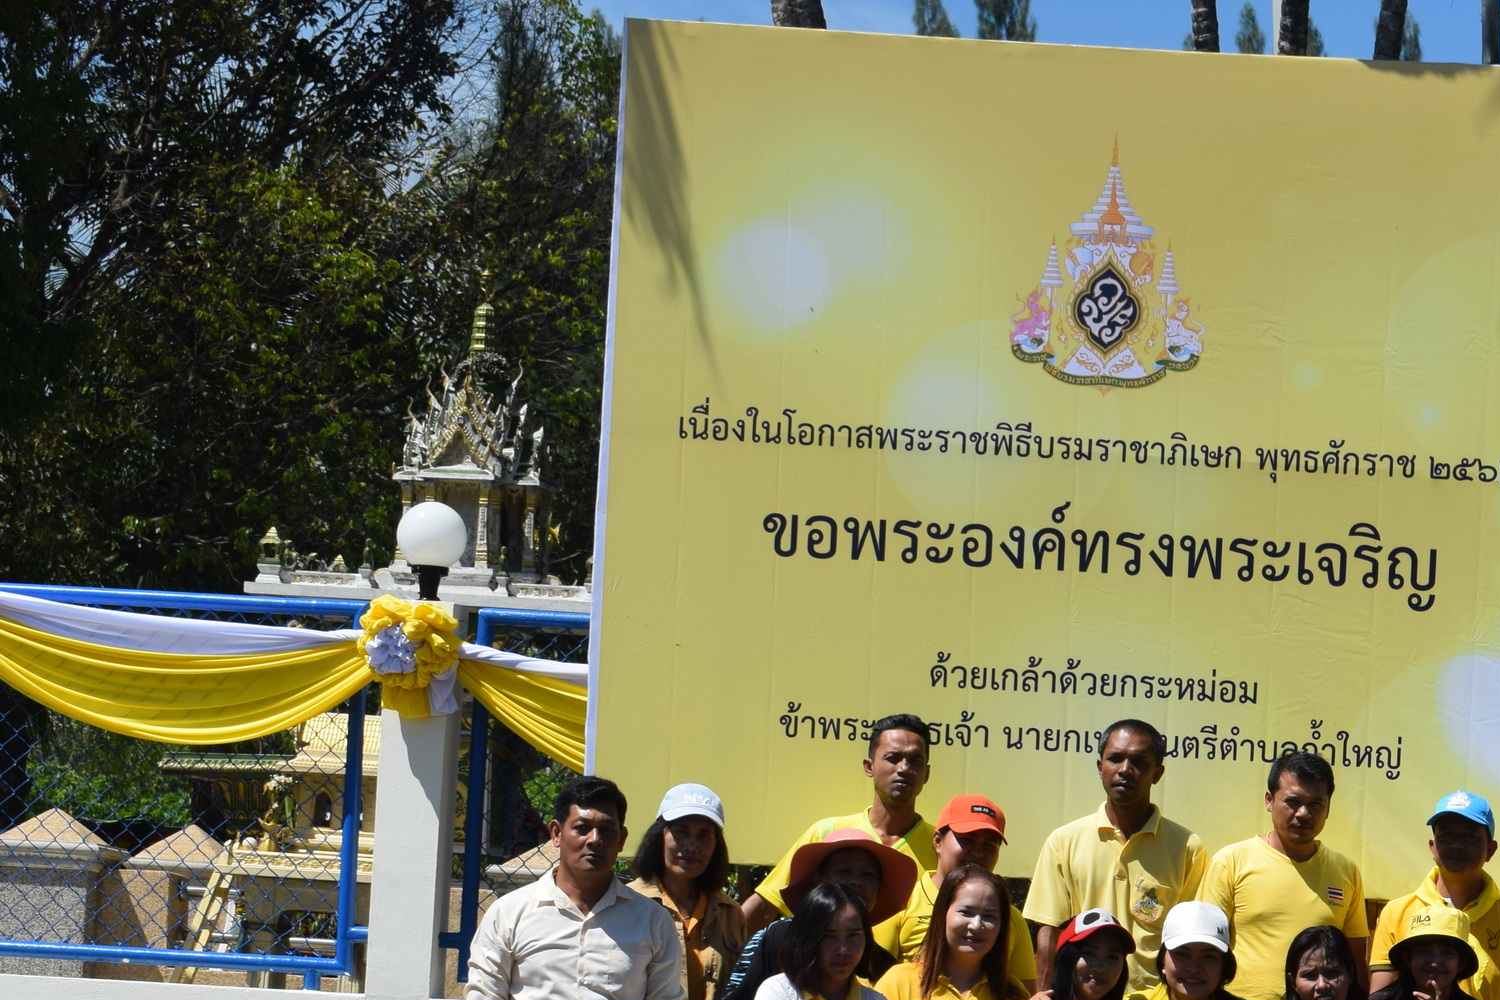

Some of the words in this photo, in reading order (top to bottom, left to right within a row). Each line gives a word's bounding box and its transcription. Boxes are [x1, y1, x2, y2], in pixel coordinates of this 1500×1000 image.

[678, 397, 1242, 469] เนื่องในโอกาสพระราชพิธีบรมราชาภิเษก
[1255, 439, 1417, 483] พุทธศักราช
[762, 501, 1438, 612] ขอพระองค์ทรงพระเจริญ
[930, 651, 1258, 704] ด้วยเกล้าด้วยกระหม่อม
[779, 701, 989, 748] ข้าพระธเจ้า
[682, 794, 711, 807] NY
